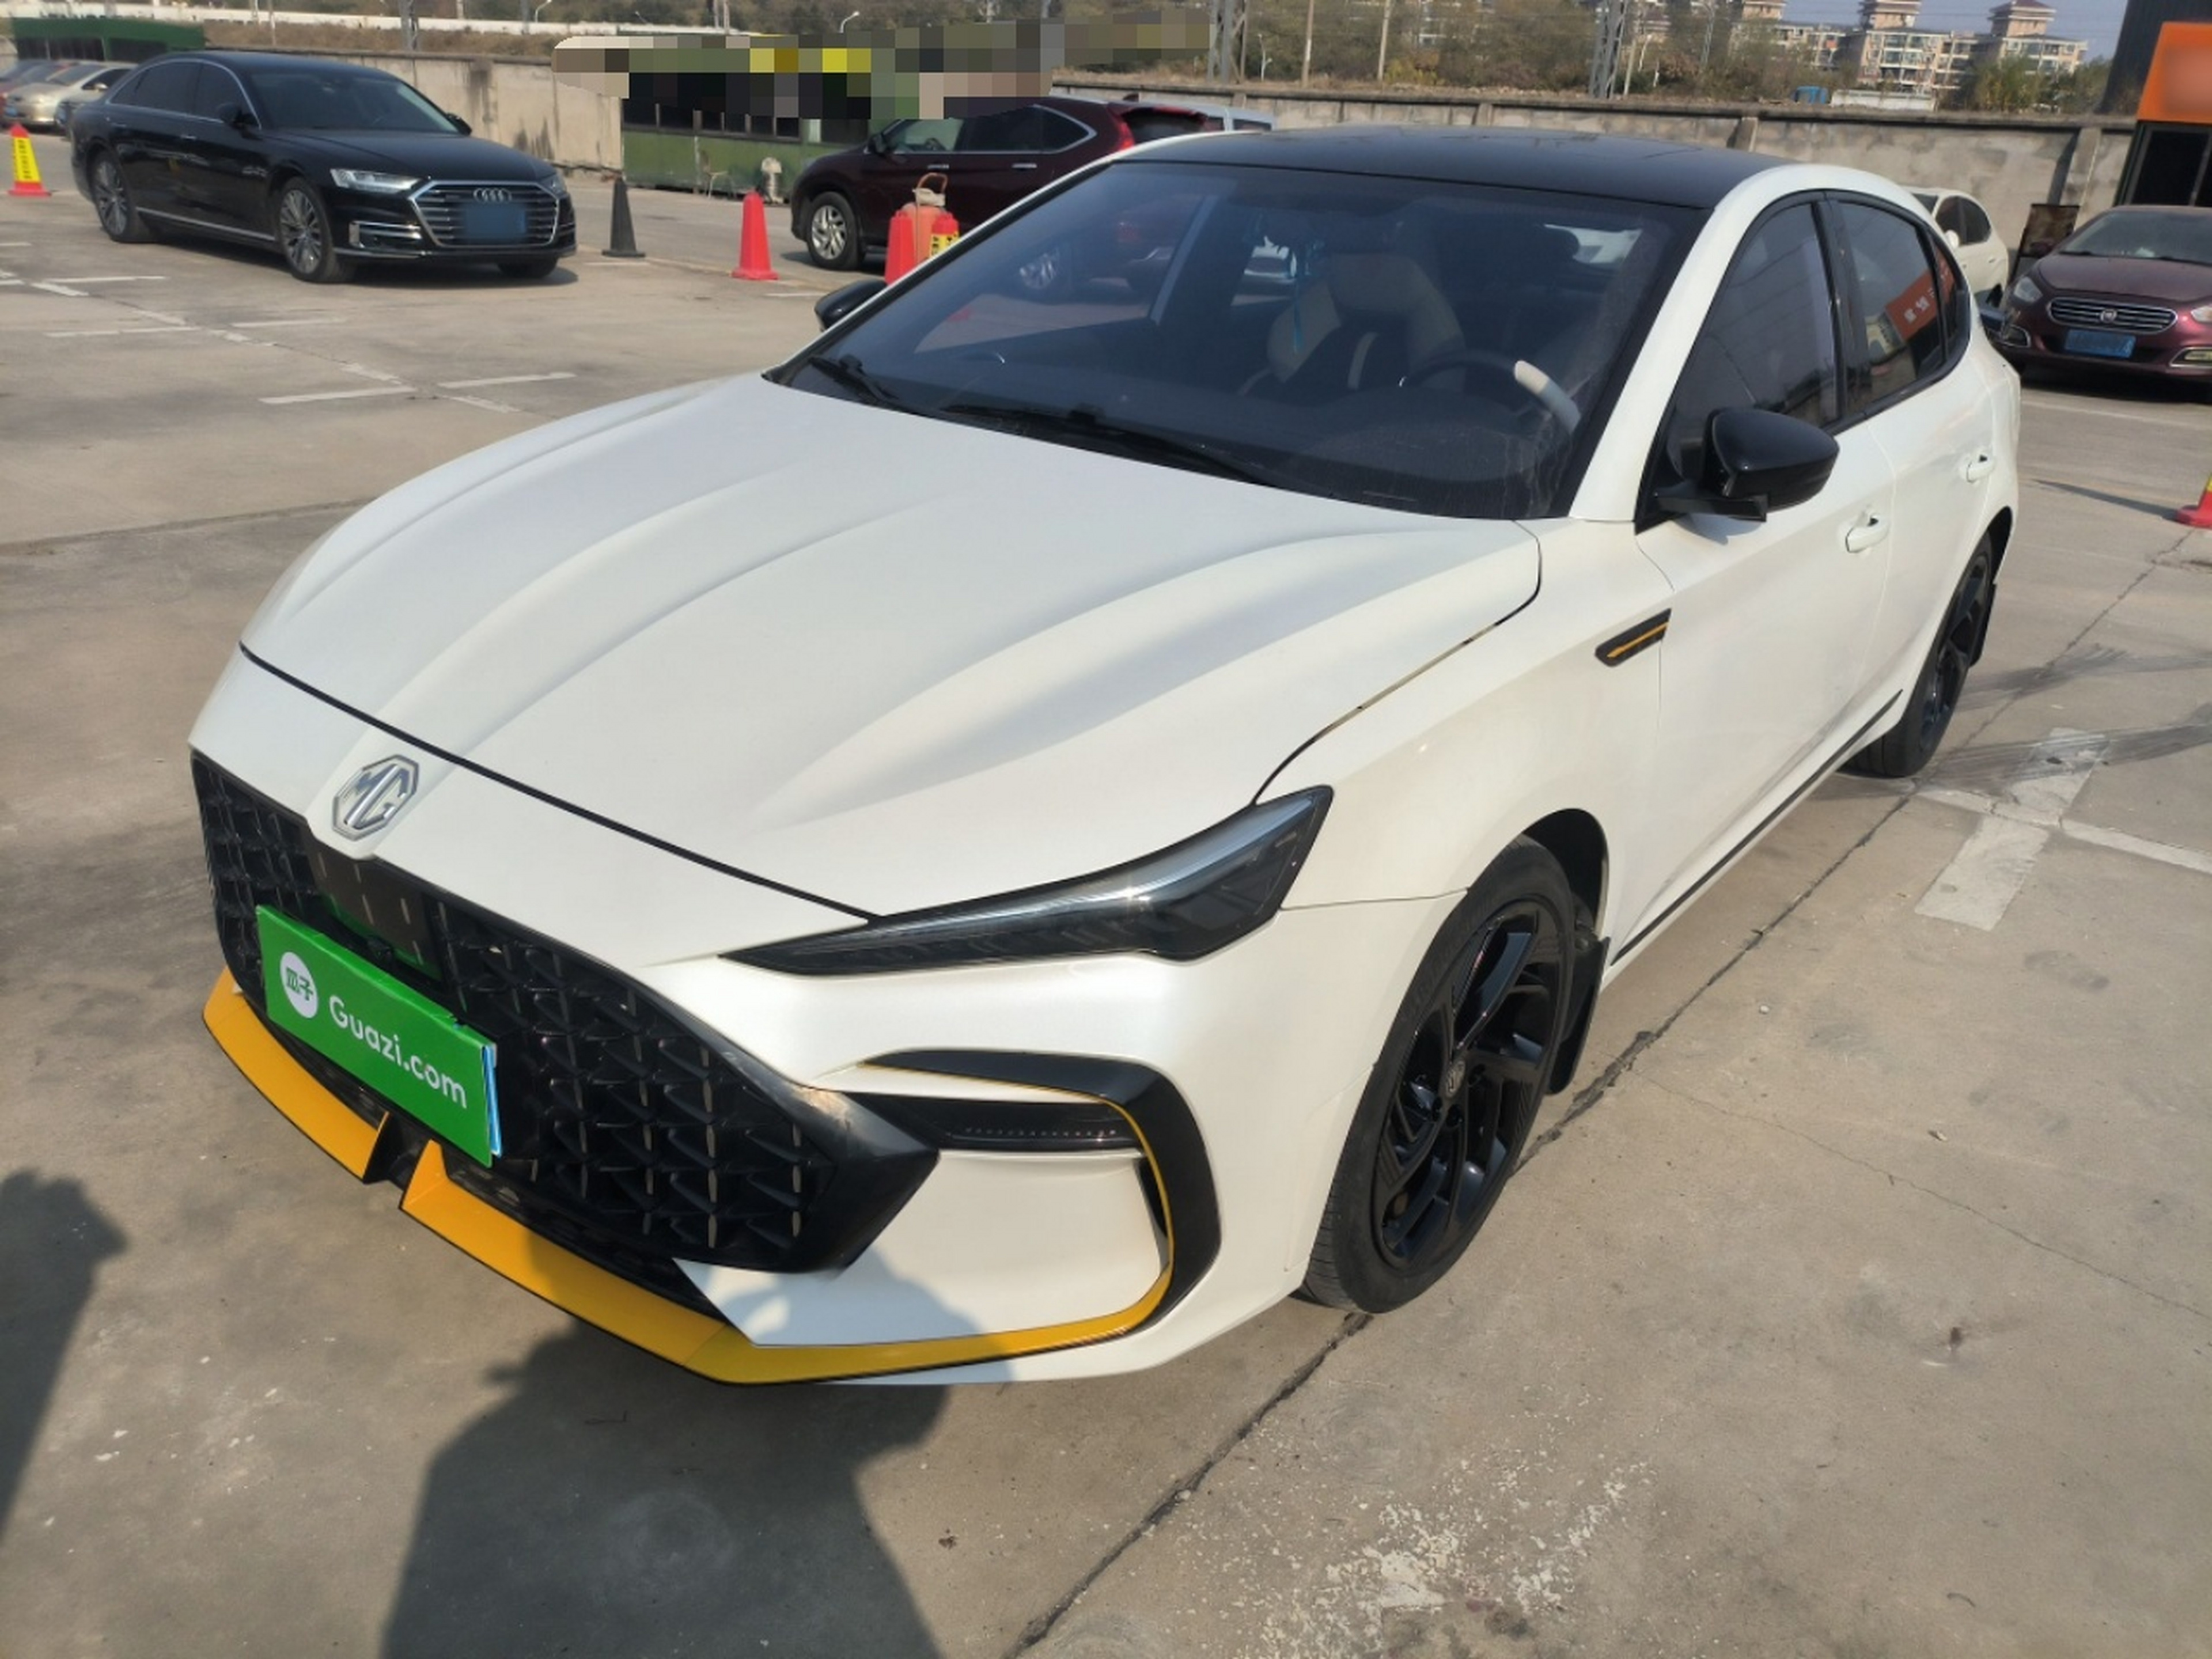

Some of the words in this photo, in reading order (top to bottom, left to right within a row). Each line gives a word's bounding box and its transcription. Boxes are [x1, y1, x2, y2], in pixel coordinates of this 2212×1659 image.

[339, 763, 410, 830] MG
[286, 966, 314, 1001] 瓜子
[328, 996, 468, 1109] Guazi.com
